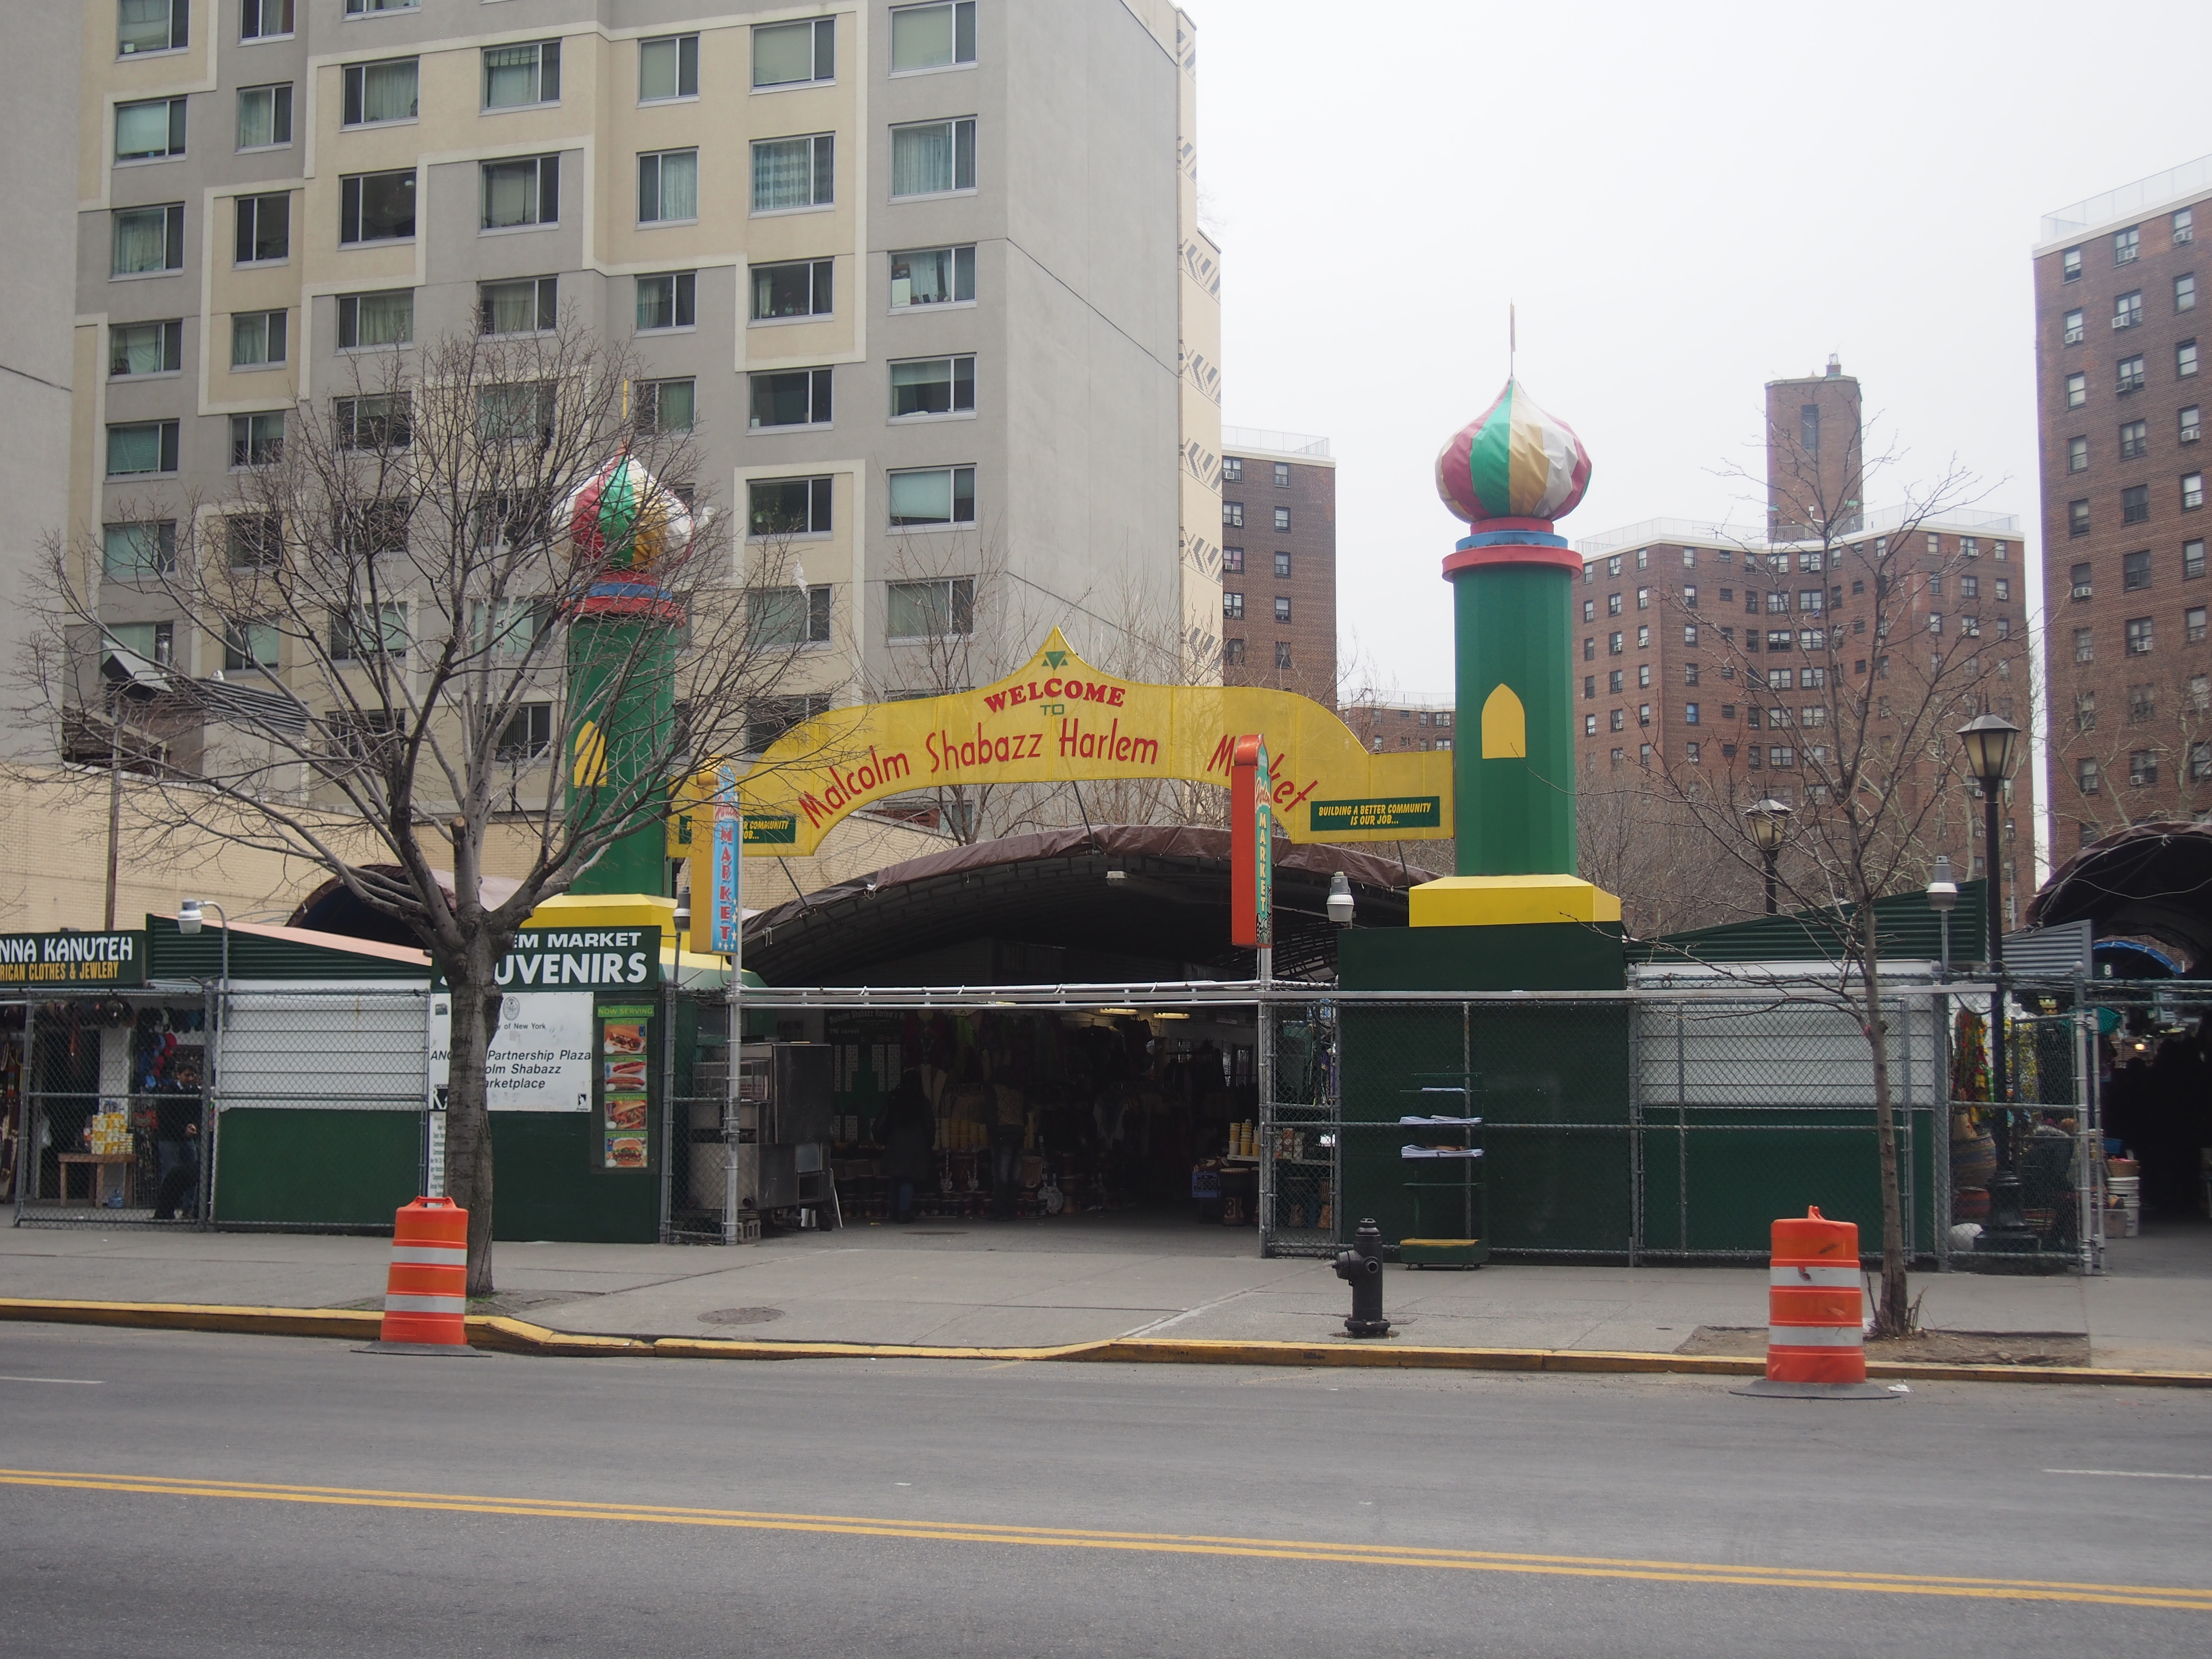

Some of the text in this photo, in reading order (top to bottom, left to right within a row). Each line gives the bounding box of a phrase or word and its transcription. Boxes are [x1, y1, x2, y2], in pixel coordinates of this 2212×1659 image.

[985, 678, 1125, 713] WELCOME
[1040, 704, 1065, 716] TO
[798, 718, 1318, 829] Malcolm Shabazz Harlem Mket
[1319, 803, 1431, 816] BUILDING A BETTER COMMUNITY
[749, 820, 789, 830] COMMUNITY
[1350, 814, 1399, 826] IS OUR JOB...
[743, 830, 759, 840] OB...
[1259, 811, 1267, 913] MARKET
[720, 825, 733, 941] MARKET
[547, 932, 641, 948] MARKET
[44, 937, 132, 962] KANUTEH
[29, 962, 66, 981] CLOTHES
[70, 962, 76, 980] &
[79, 961, 119, 979] JEWLERY
[440, 952, 647, 985] UVENIRS
[2104, 964, 2111, 975] 8
[488, 1049, 591, 1062] Partnership Plaza
[511, 1064, 561, 1074] Shabazz
[485, 1078, 546, 1090] arketplace
